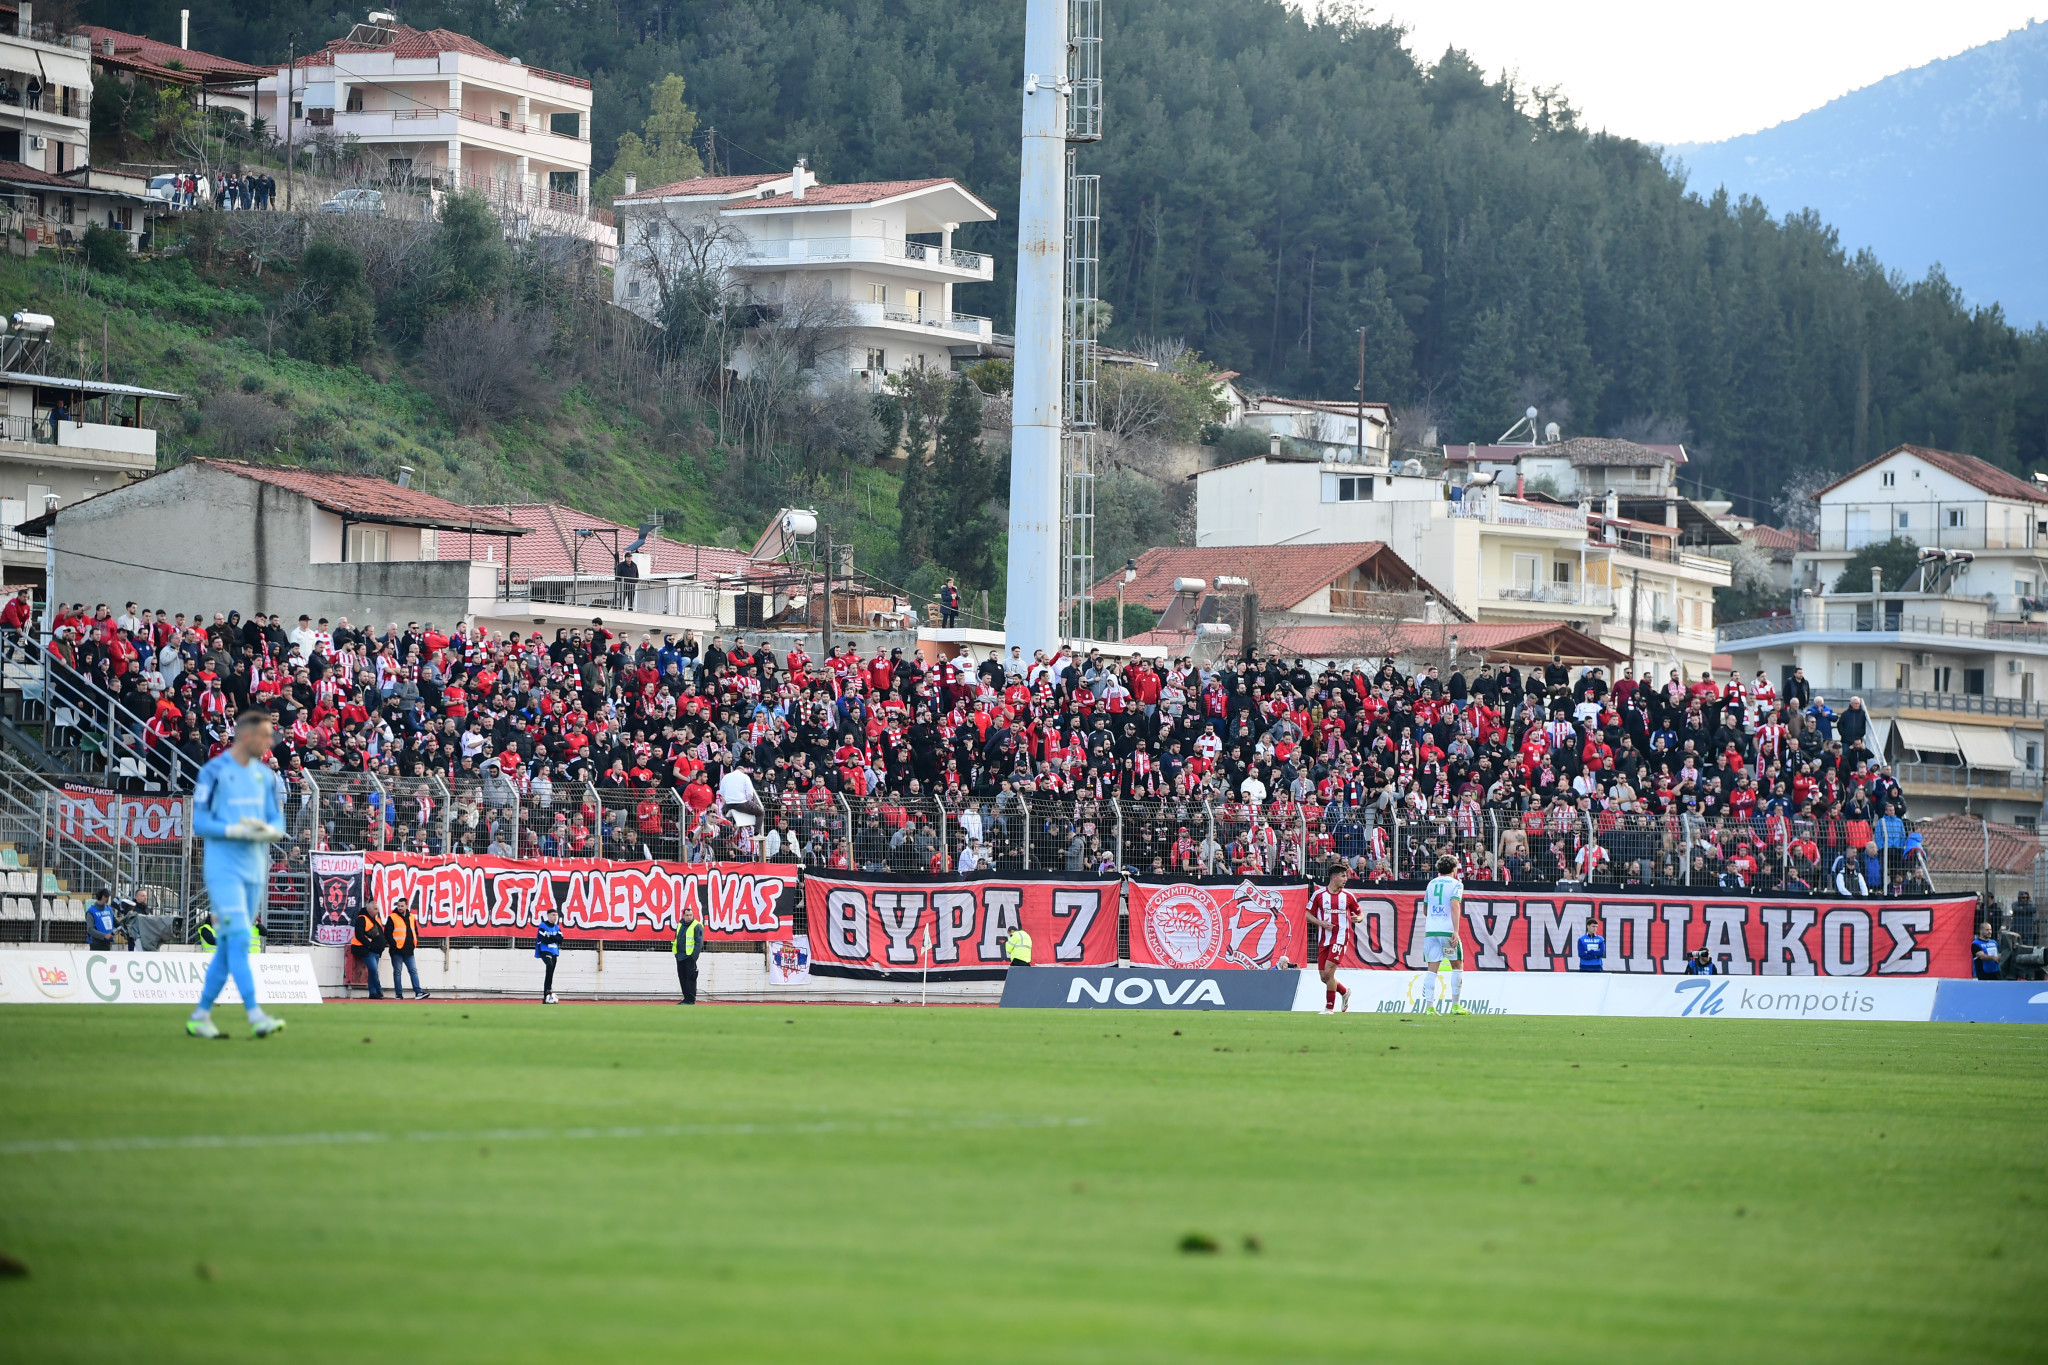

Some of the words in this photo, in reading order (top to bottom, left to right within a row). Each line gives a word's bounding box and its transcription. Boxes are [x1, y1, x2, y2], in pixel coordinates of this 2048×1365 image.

[64, 782, 114, 796] ΟΛΥΜΠΙΑΚΟΣ
[58, 797, 184, 839] ΤΡΙΠΟΛ
[317, 859, 359, 872] LEVADIA
[372, 865, 488, 926] ΛΕΥΤΕΡΙΑ
[494, 873, 557, 925] ΣΤΑ
[565, 867, 700, 928] ΑΔΕΡΦΙΑ
[709, 870, 781, 928] ΜΑΣ
[1155, 887, 1211, 906] ΟΛΥΜΠΙΑΚΟΣ
[1434, 884, 1444, 905] 4
[320, 928, 342, 942] GATE
[345, 929, 352, 941] 7
[827, 888, 1022, 964] ΘΥΡΑ
[1053, 888, 1101, 962] 7
[1332, 944, 1343, 955] 84
[37, 966, 67, 984] Dole
[133, 989, 168, 999] ENERGY
[178, 990, 202, 999] SYST
[1066, 977, 1225, 1005] NOVA
[1377, 1000, 1405, 1013] ΑΦΟΙ
[1411, 999, 1489, 1014] ΑΙΑΤΡΙΝΗ
[1740, 988, 1875, 1016] kompotis
